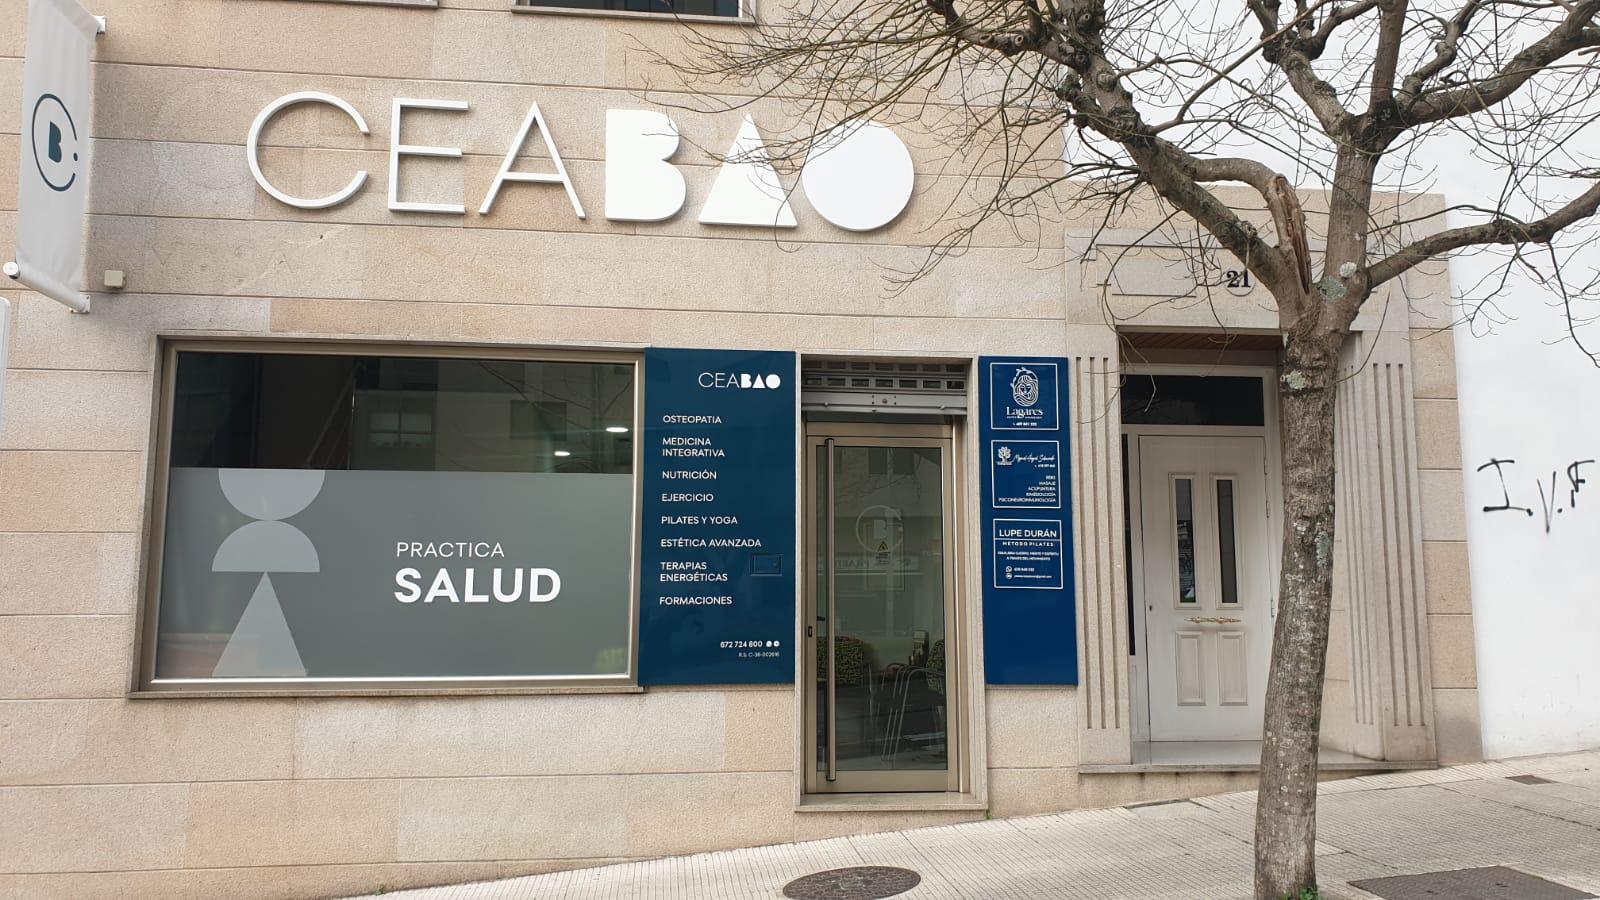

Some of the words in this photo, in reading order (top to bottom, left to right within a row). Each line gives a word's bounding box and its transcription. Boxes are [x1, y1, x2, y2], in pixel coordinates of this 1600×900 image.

[247, 91, 914, 232] CEABAO
[1226, 270, 1251, 288] 21
[698, 372, 781, 389] CEABAO
[1006, 406, 1043, 419] Lagares
[662, 415, 722, 424] OSTEOPATIA
[662, 437, 711, 446] MEDICINA
[662, 449, 725, 457] INTEGRATIVA
[662, 469, 717, 480] NUTRICIÓN
[661, 493, 714, 502] EJERCICIO
[661, 516, 699, 525] PILATES
[701, 516, 708, 524] Y
[709, 516, 738, 525] YOGA
[999, 529, 1022, 537] LUPE
[1024, 529, 1057, 538] DURÁN
[660, 537, 706, 547] ESTÉTICA
[709, 538, 762, 547] AVANZADA
[396, 542, 505, 558] PRACTICA
[660, 561, 707, 570] TERAPIAS
[660, 572, 728, 582] ENERGÉTICAS
[394, 567, 561, 603] SALUD
[659, 596, 733, 605] FORMACIONES
